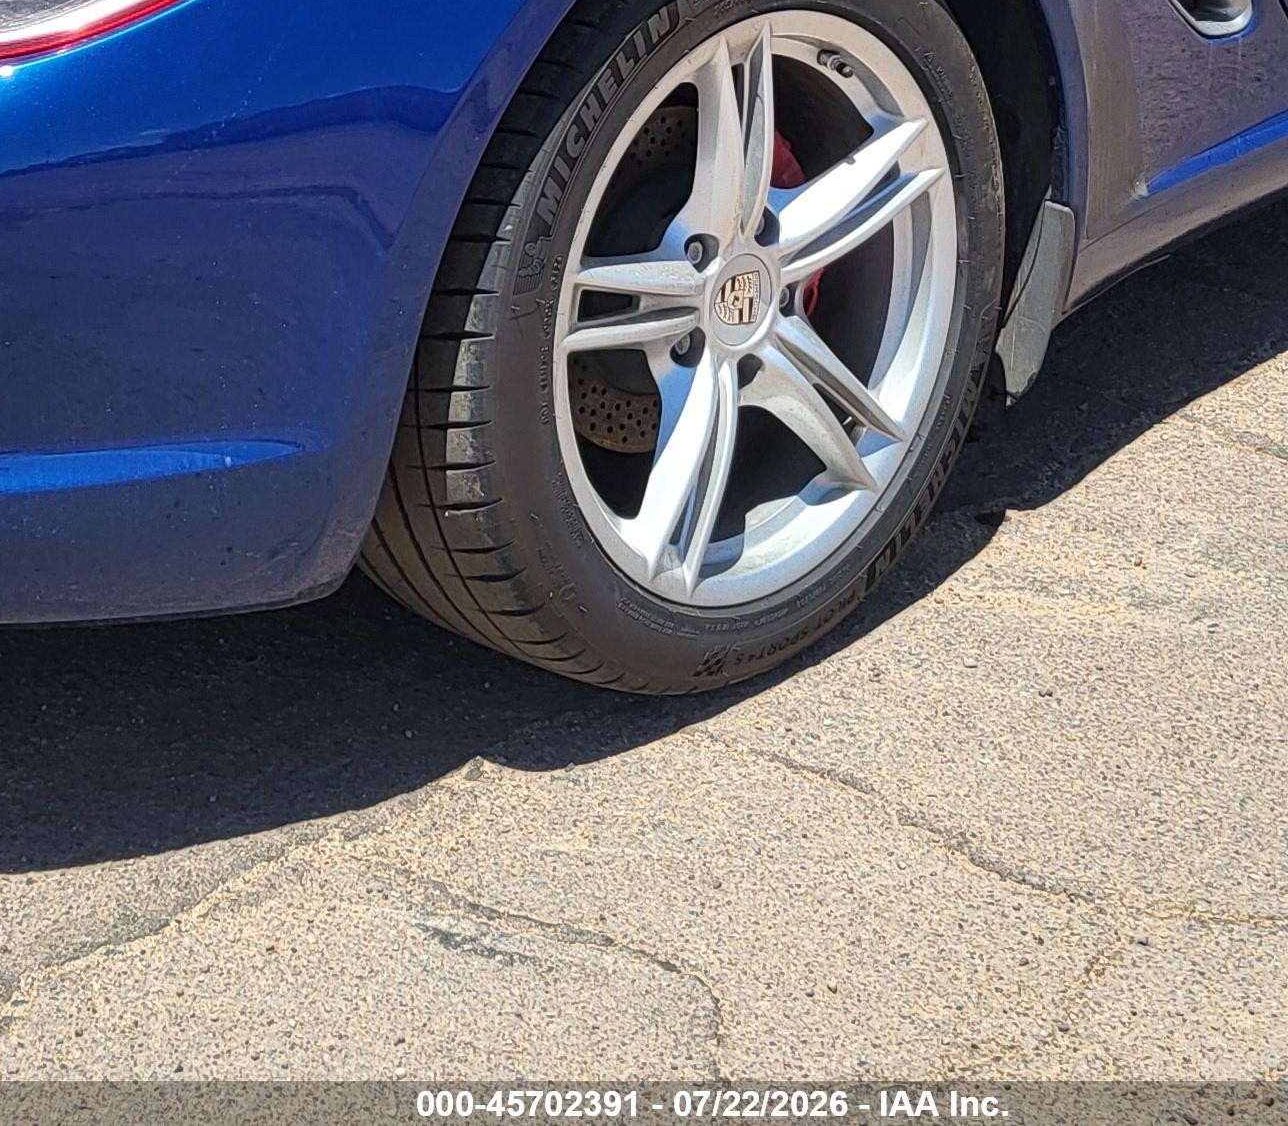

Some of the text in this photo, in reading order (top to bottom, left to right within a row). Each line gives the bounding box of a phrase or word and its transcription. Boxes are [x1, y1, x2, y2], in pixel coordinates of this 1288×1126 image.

[535, 5, 672, 226] MICHELIN
[815, 589, 861, 633] PILOT
[755, 625, 809, 660] SPORT
